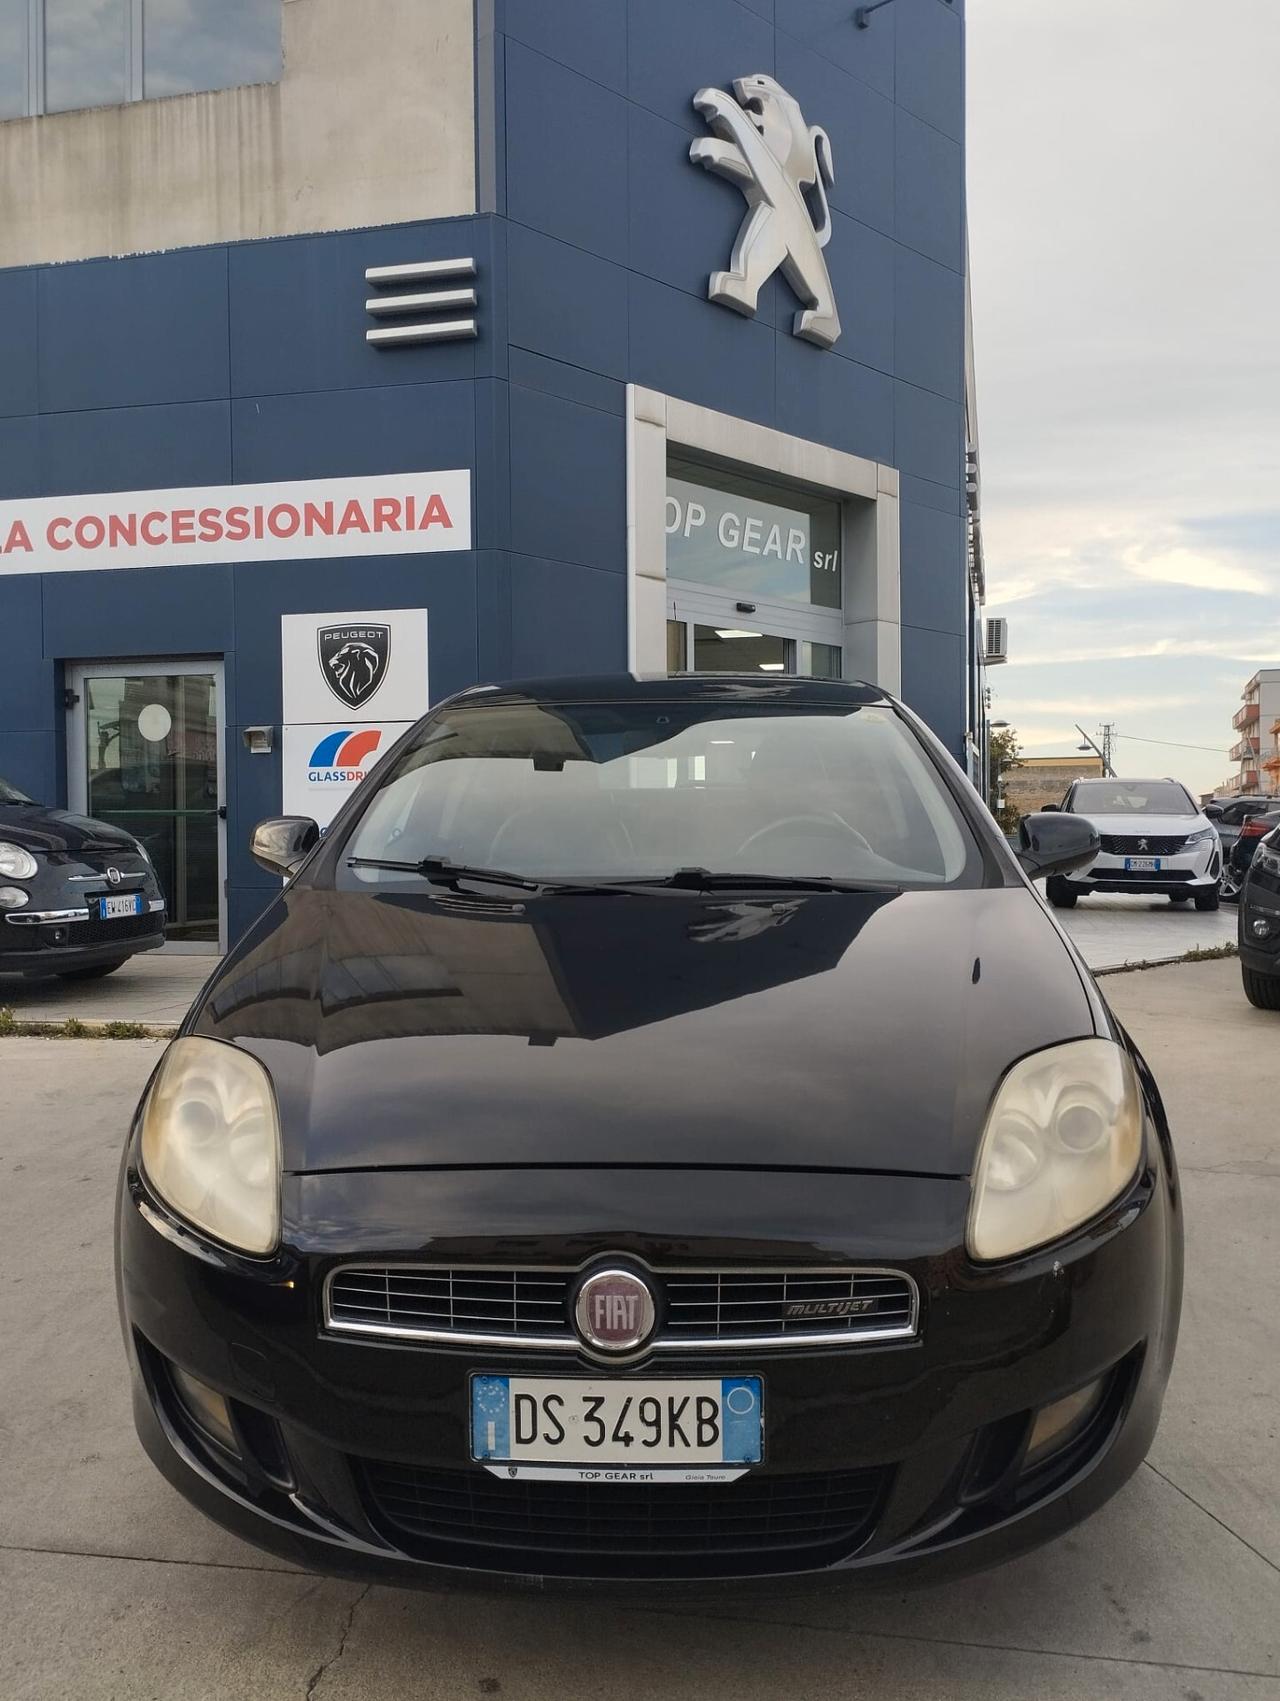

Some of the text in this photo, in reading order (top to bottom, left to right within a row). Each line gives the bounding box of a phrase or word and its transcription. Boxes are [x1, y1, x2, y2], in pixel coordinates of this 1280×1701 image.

[0, 494, 454, 554] A CONCESSIONARIA
[665, 496, 839, 572] OP GEAR srl
[324, 630, 384, 641] PEUGEOT
[595, 1294, 639, 1330] FIAT
[787, 1300, 874, 1316] MULTIJET
[514, 1393, 565, 1445] DS
[582, 1395, 720, 1448] 349KB
[578, 1471, 654, 1481] TOP GEAR srl
